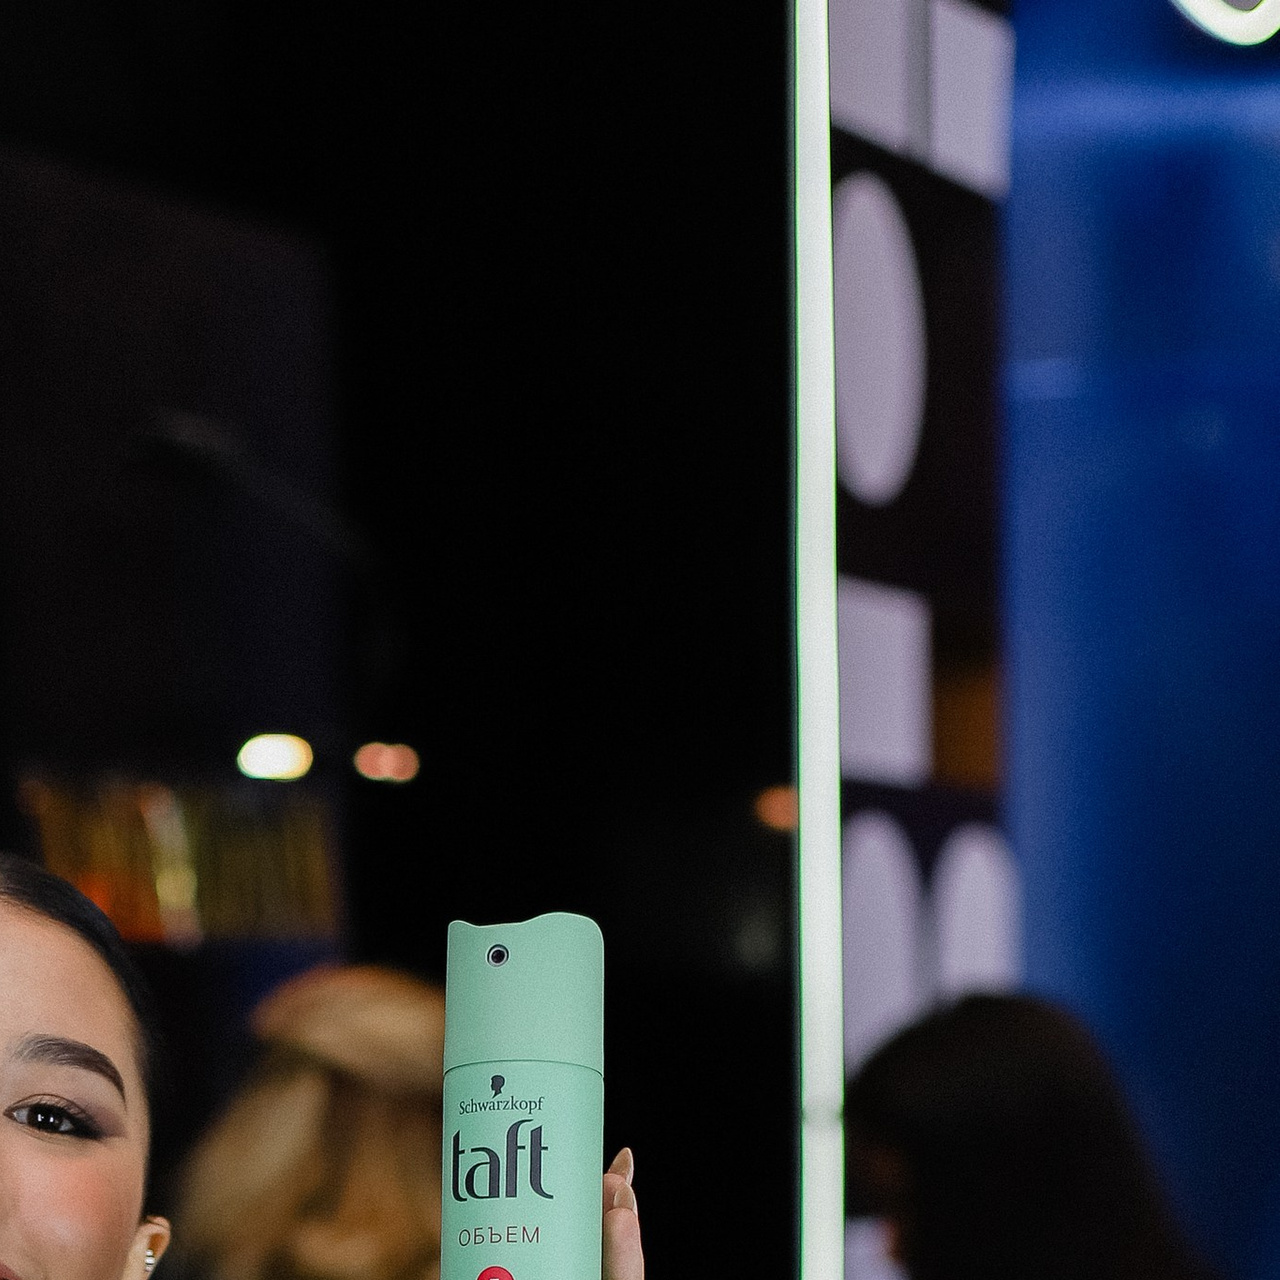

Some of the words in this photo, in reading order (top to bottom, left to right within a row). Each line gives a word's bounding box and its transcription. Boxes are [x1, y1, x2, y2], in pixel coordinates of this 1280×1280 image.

[458, 1096, 545, 1116] Schwarzkopf
[451, 1118, 555, 1202] taft
[458, 1226, 541, 1247] ОБЪЕМ
